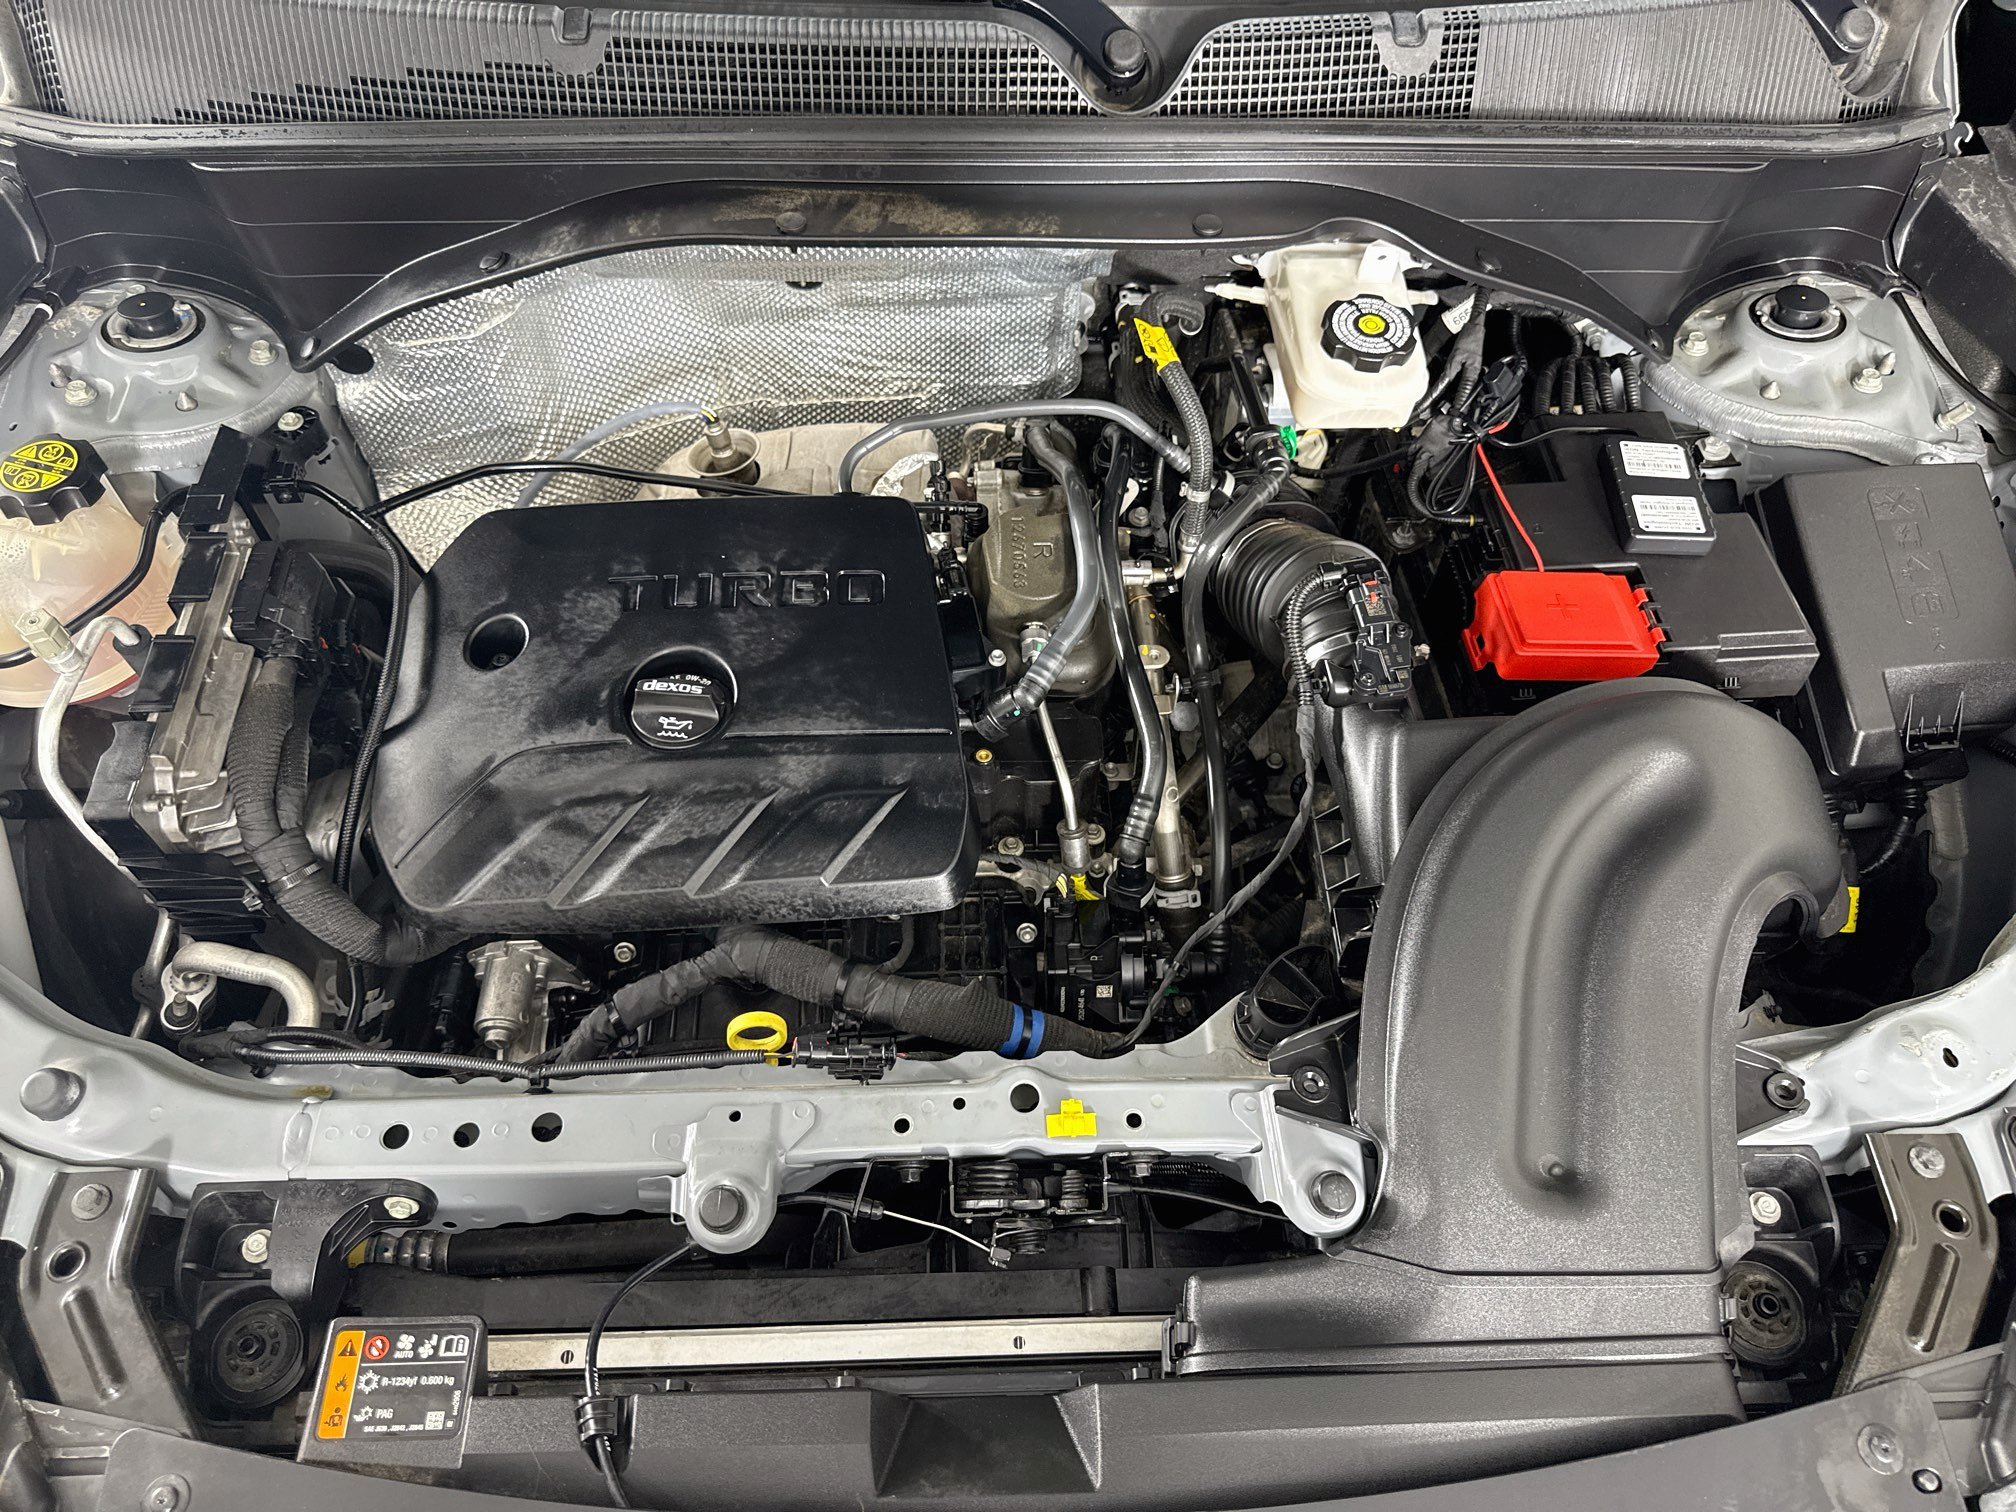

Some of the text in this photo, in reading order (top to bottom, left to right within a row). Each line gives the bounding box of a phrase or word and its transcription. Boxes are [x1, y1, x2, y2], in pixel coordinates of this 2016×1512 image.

[1033, 542, 1054, 558] R
[608, 570, 886, 611] TURBO
[642, 679, 705, 694] dexos
[394, 1350, 414, 1359] AUTO
[382, 1375, 455, 1387] R-1234yf 0.600 kg
[376, 1408, 394, 1418] PAG
